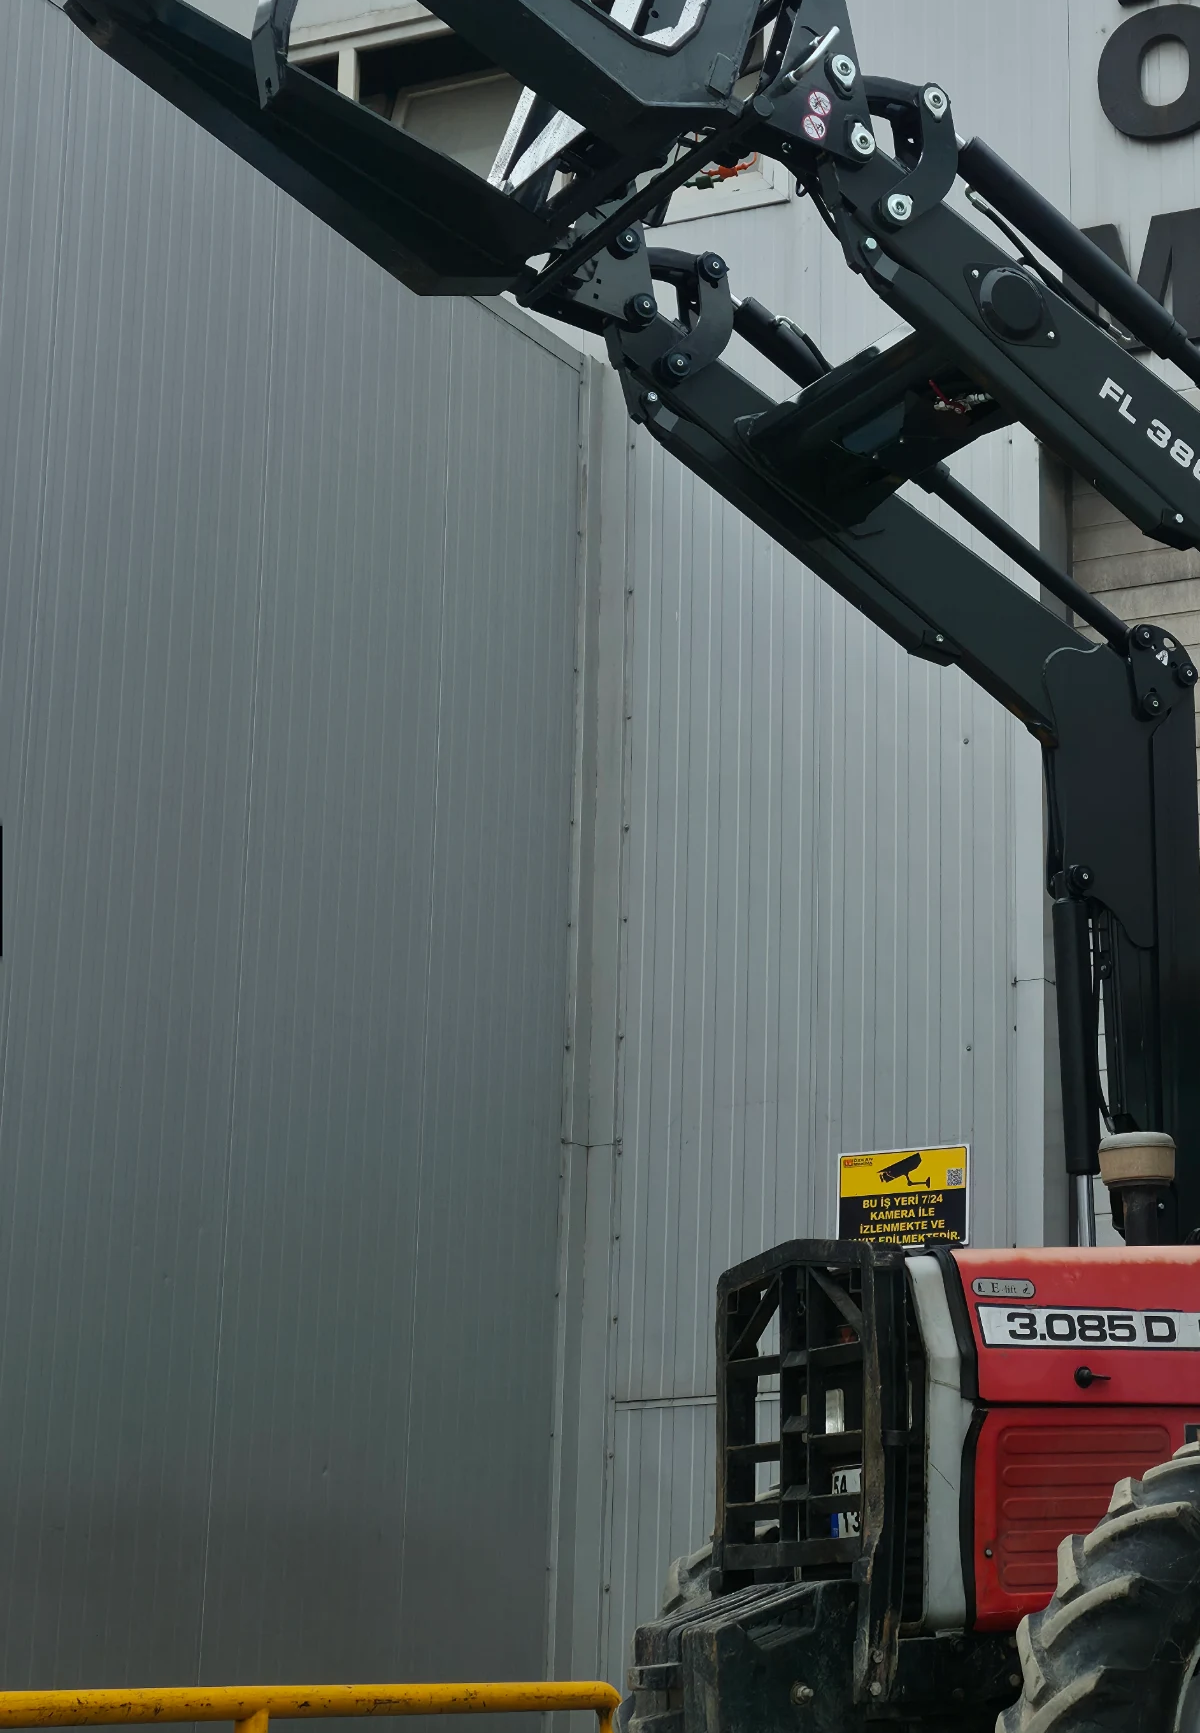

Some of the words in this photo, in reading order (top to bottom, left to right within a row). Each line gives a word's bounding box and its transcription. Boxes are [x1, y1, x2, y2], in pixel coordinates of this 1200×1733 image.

[1098, 377, 1137, 425] FL
[862, 1199, 877, 1209] BU
[880, 1197, 891, 1209] İŞ
[893, 1194, 919, 1206] YERİ
[921, 1194, 944, 1204] 7/24
[870, 1209, 915, 1221] KAMERA
[918, 1206, 935, 1217] İLE
[860, 1221, 928, 1234] İZLENMEKTE
[930, 1219, 945, 1229] VE
[1006, 1311, 1137, 1343] 3.085
[1146, 1315, 1177, 1343] D
